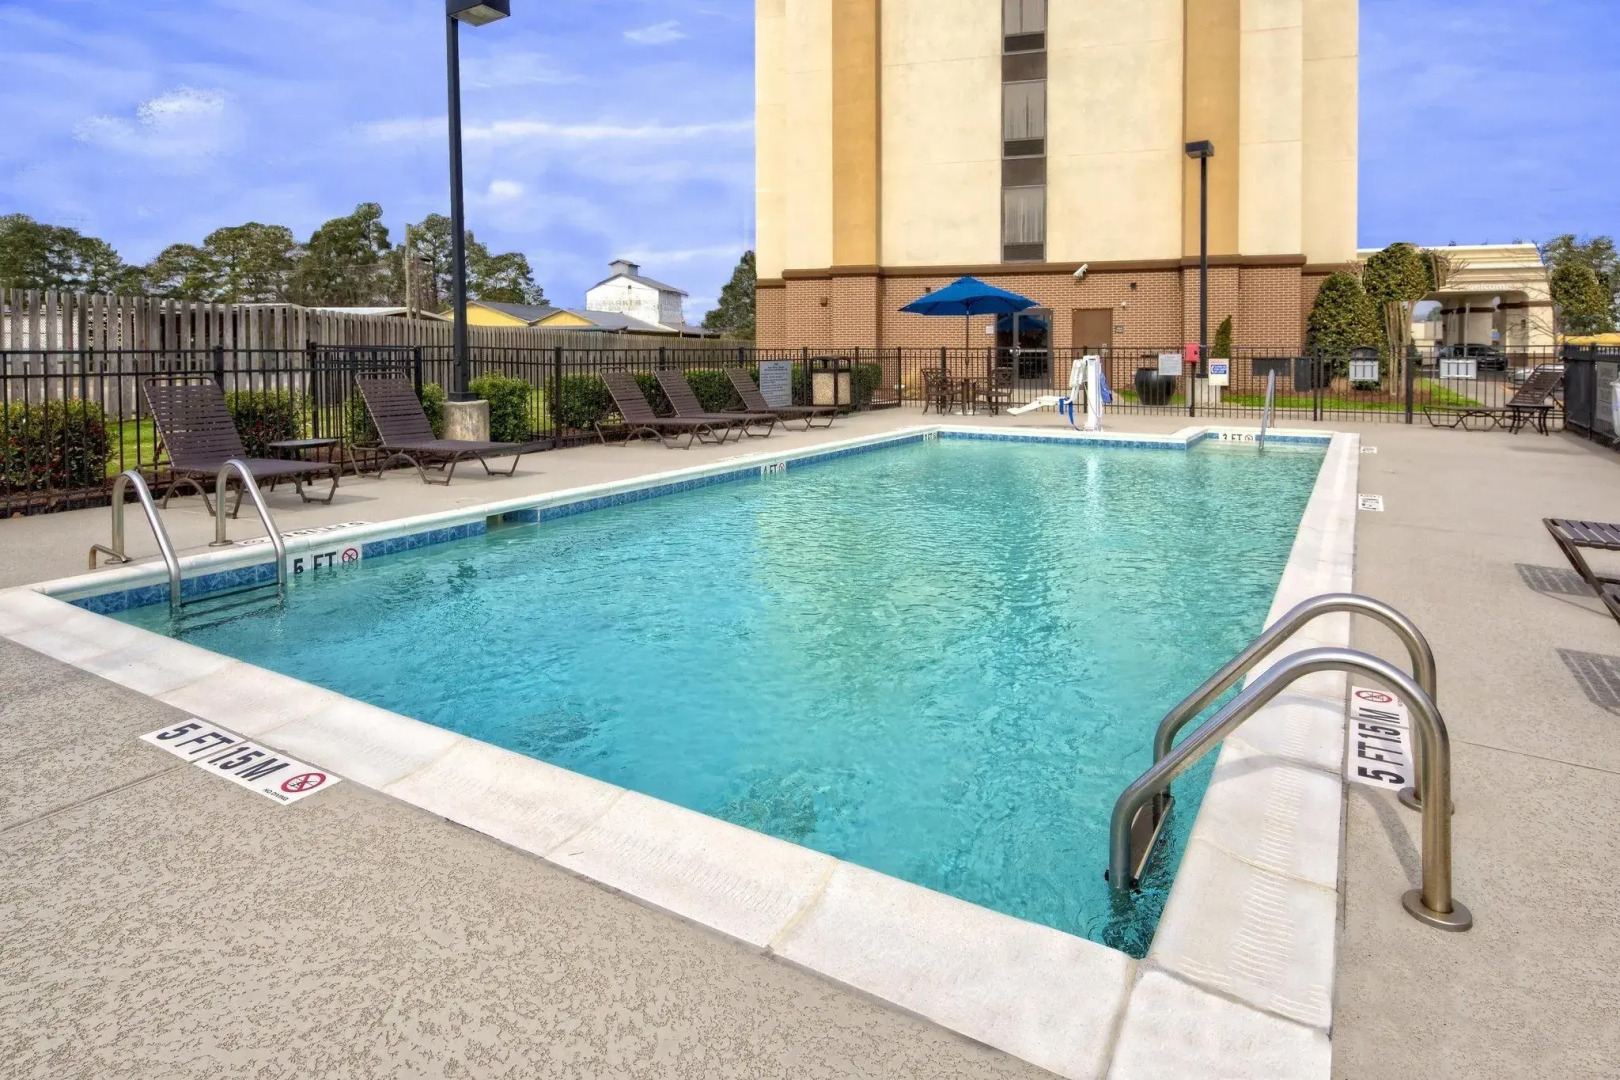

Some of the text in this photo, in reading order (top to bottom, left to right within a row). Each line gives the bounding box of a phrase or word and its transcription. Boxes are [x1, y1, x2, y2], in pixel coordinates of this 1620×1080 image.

[313, 551, 337, 570] FT
[156, 722, 203, 740] 5
[174, 731, 236, 755] FT
[1357, 741, 1404, 766] FT
[1357, 765, 1405, 785] 5
